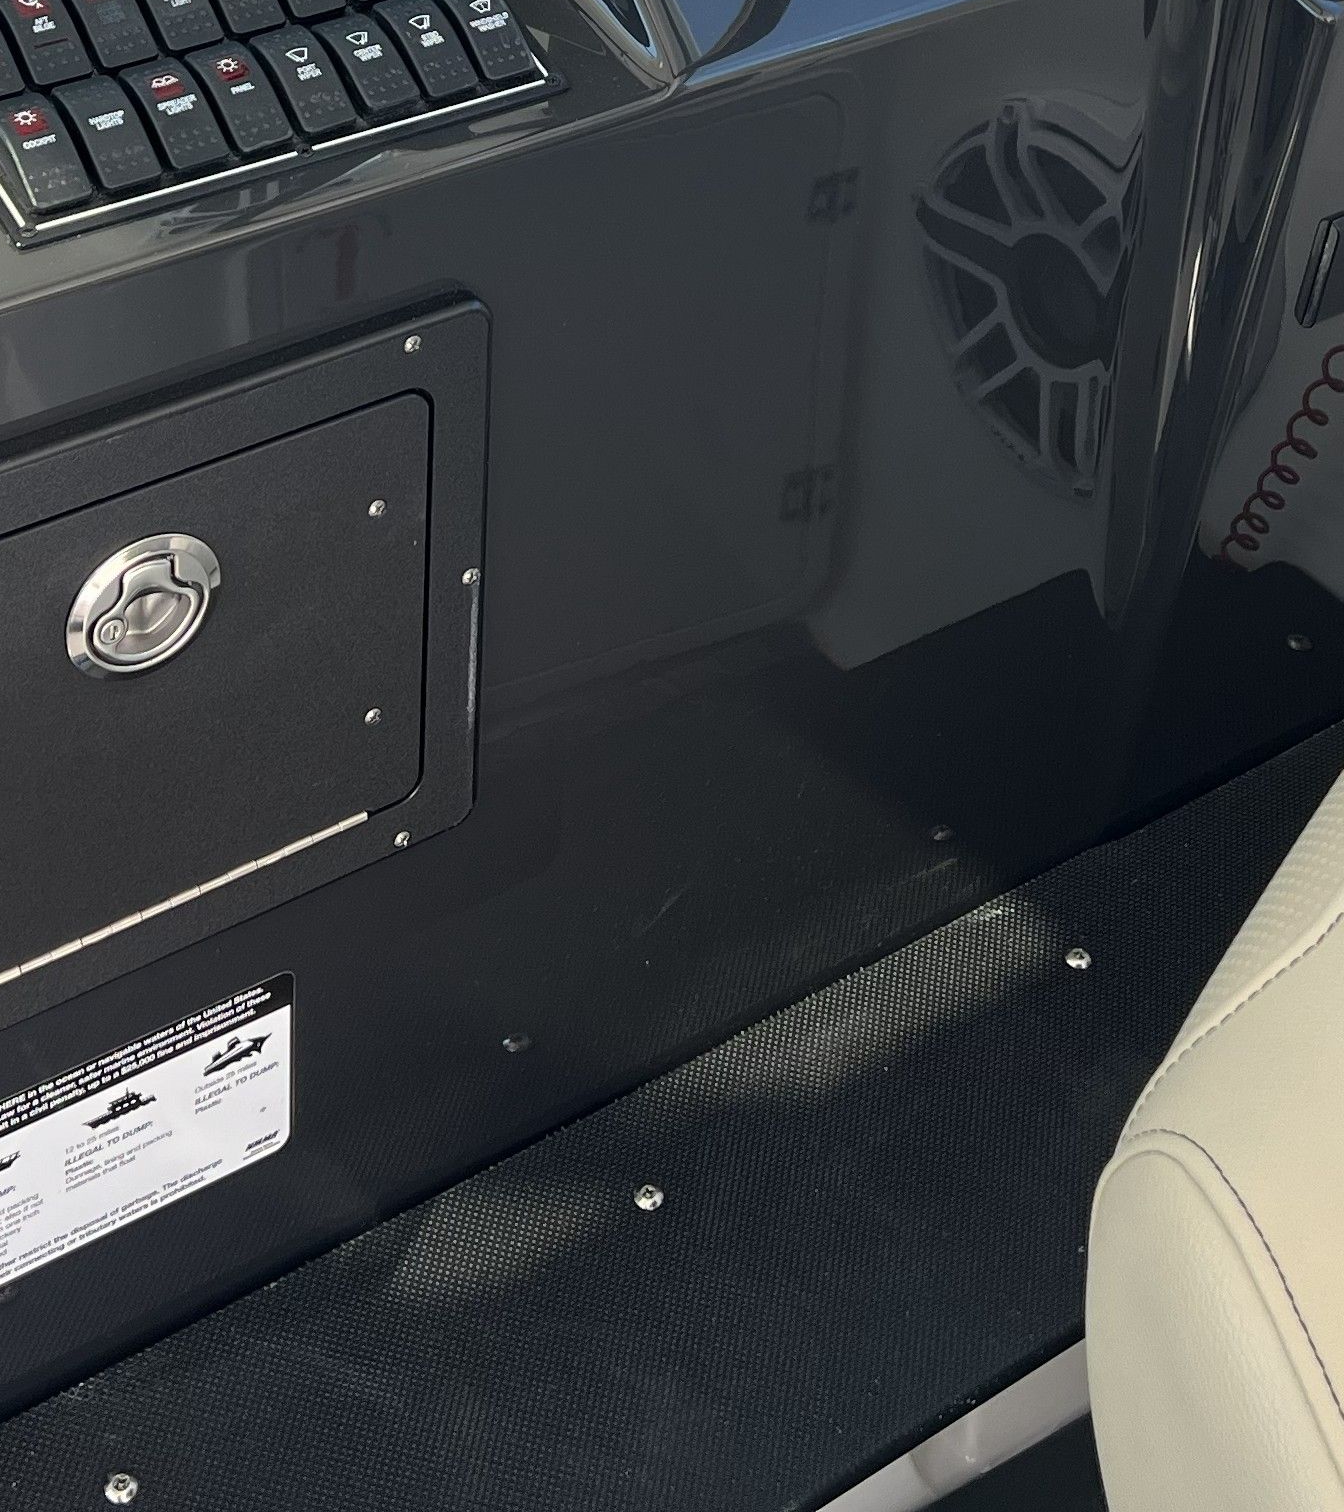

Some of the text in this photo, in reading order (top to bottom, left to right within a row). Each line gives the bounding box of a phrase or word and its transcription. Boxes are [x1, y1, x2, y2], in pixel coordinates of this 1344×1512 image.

[230, 82, 255, 94] PANEL
[157, 93, 197, 111] SPREADER
[166, 102, 194, 116] LIGHTS
[88, 109, 125, 126] HARDTOP
[96, 117, 124, 131] LIGHTS
[22, 134, 56, 149] COCKPIT
